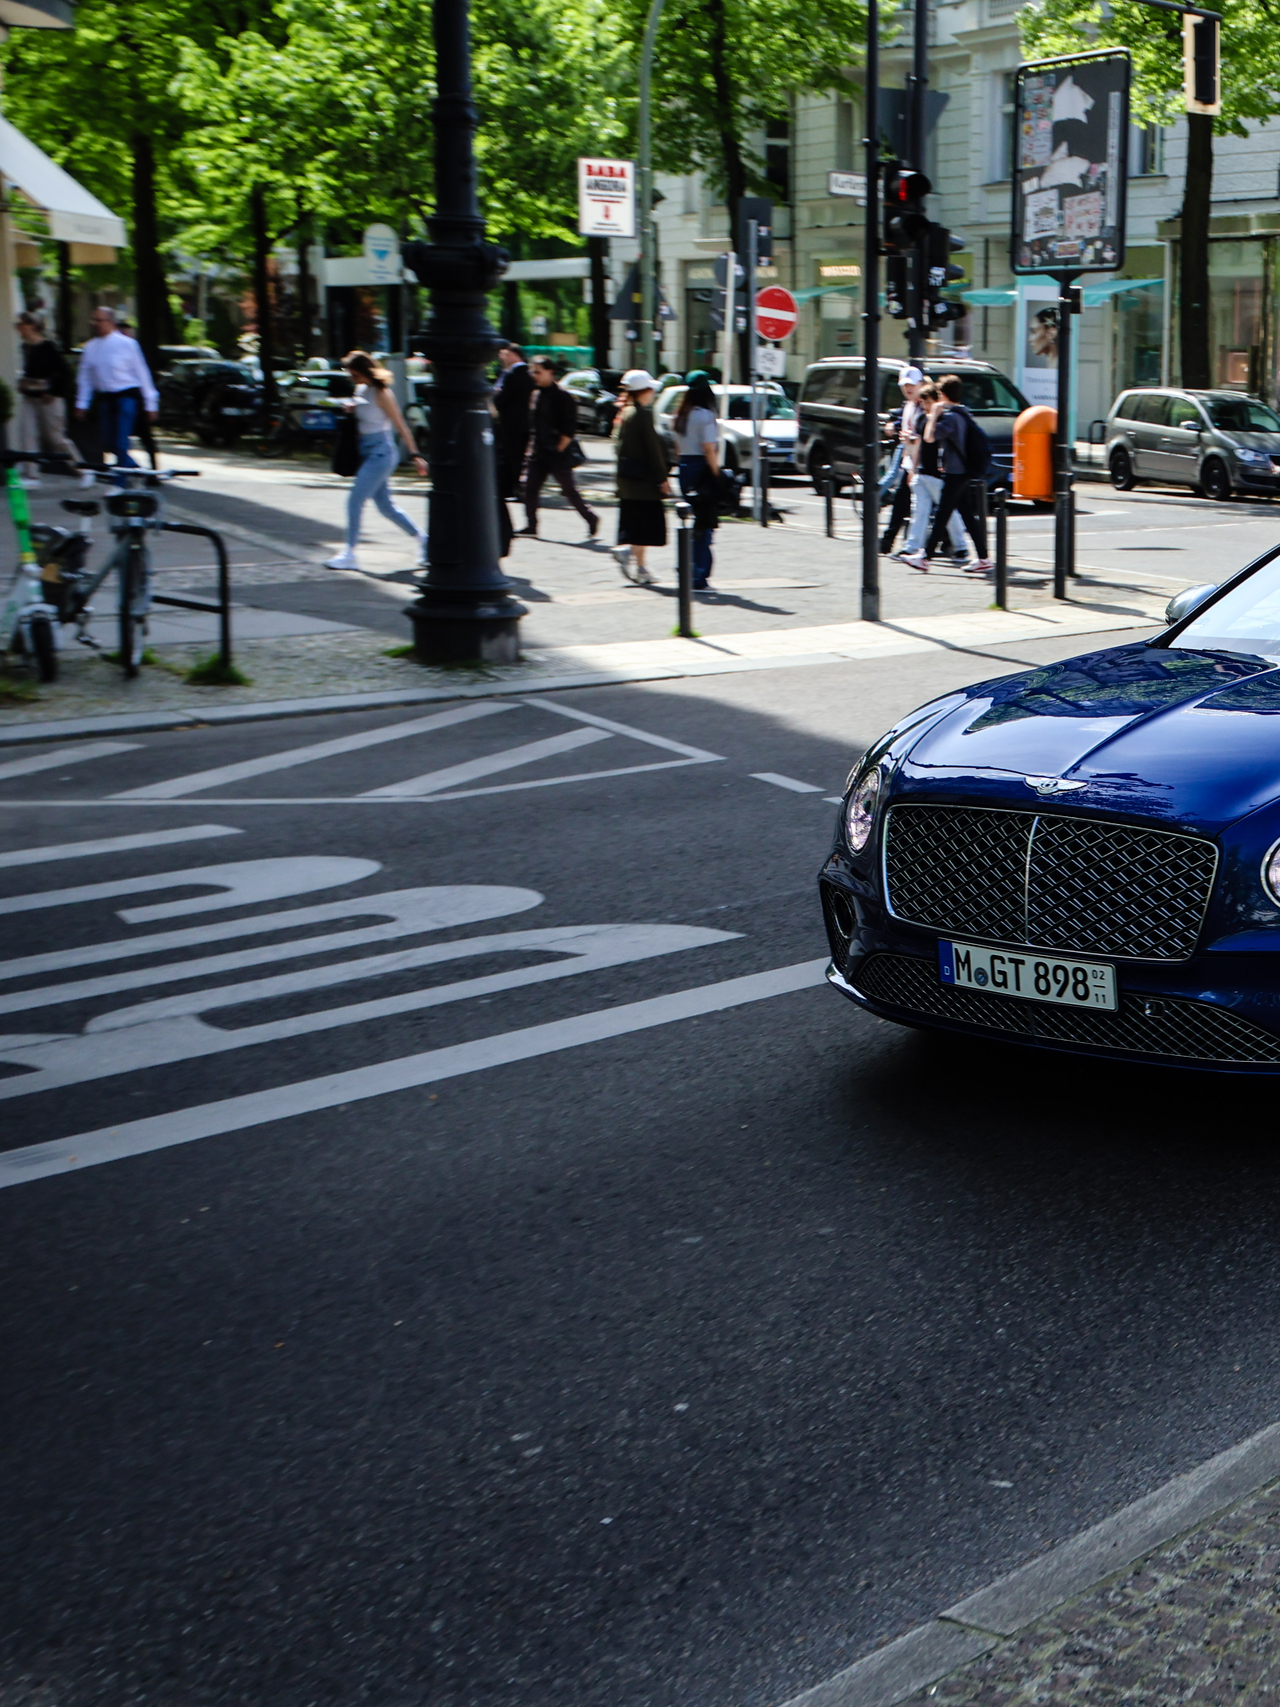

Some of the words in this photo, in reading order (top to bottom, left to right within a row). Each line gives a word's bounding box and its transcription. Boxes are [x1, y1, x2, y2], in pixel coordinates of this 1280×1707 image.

[586, 164, 627, 178] BABA
[954, 947, 972, 983] M
[989, 954, 1026, 992] GT
[1034, 961, 1090, 1001] 898
[1092, 969, 1106, 981] 02
[1094, 992, 1107, 1004] 11
